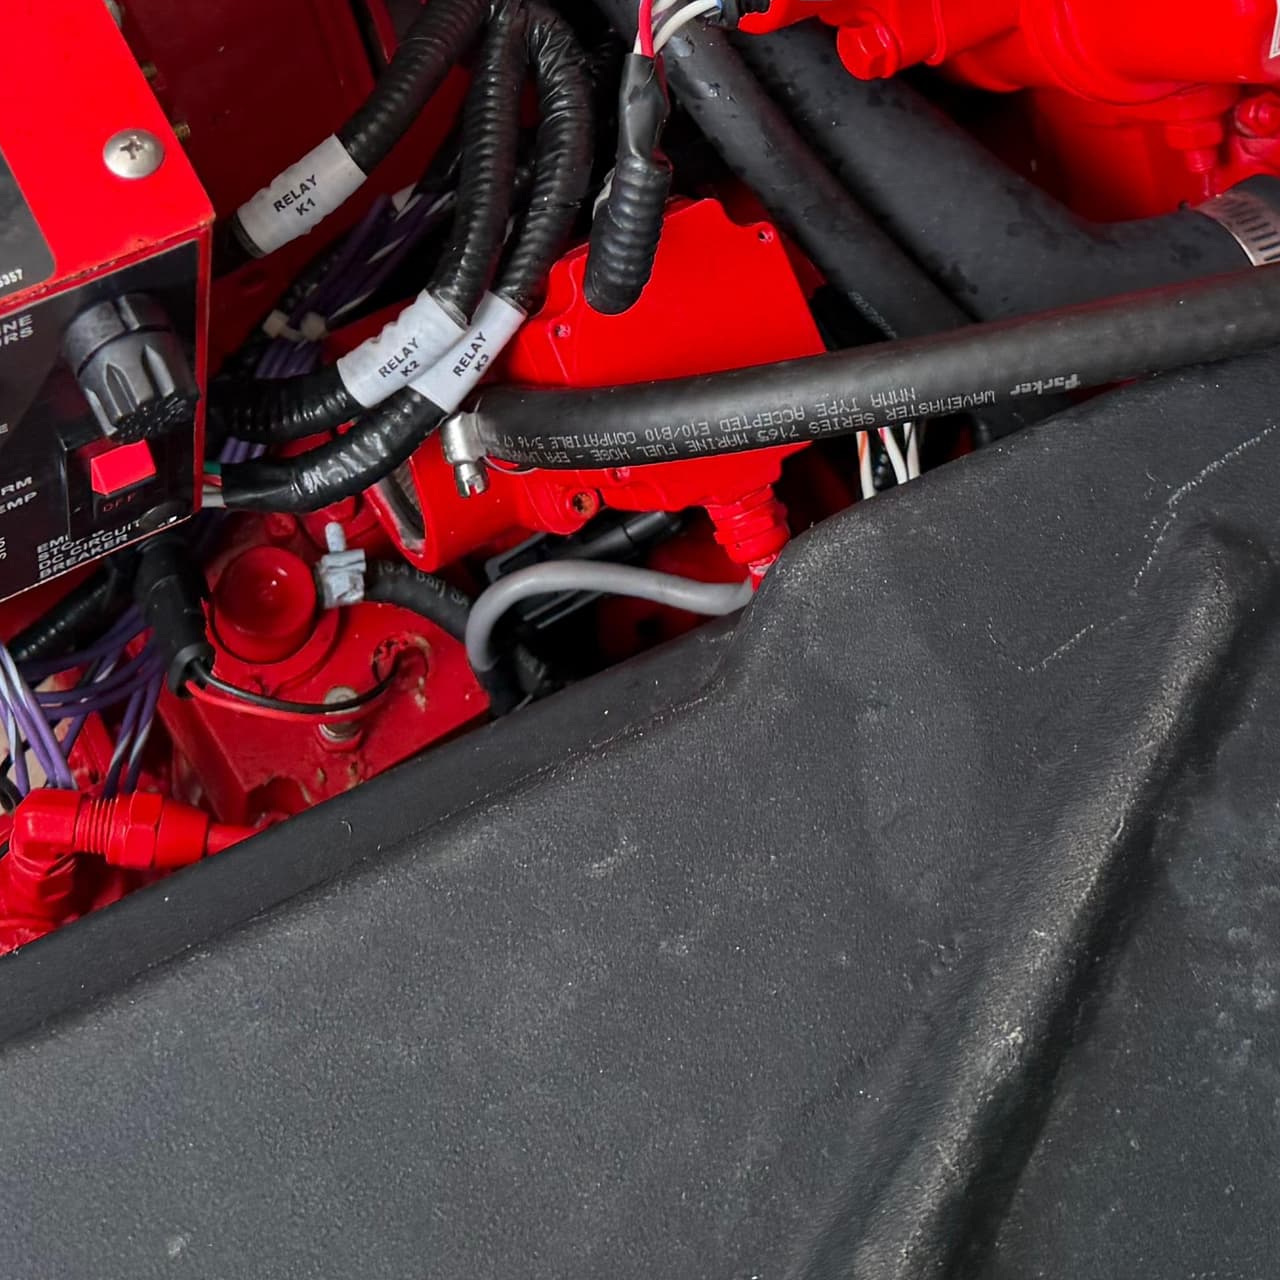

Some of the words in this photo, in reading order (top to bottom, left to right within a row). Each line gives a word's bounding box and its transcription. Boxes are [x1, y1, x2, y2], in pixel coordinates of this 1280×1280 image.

[272, 174, 317, 213] RELAY
[295, 197, 316, 216] K1
[377, 337, 420, 378] RELAY
[452, 331, 487, 377] RELAY
[473, 354, 490, 373] K3
[400, 360, 421, 377] K2
[1010, 373, 1081, 396] Parker
[816, 397, 860, 417] TYPE
[871, 386, 916, 409] NMMA
[885, 389, 996, 420] WAVEMASTER
[720, 404, 806, 433] ACCEPTED
[809, 412, 876, 434] SERIES
[551, 431, 638, 449] COMPATIBLE
[645, 422, 711, 442] E10/B10
[687, 432, 750, 452] MARINE
[593, 448, 631, 462] HOSE
[636, 442, 676, 458] FUEL
[38, 554, 64, 571] DC
[70, 519, 141, 558] CIRCUIT
[39, 533, 129, 580] BREAKER
